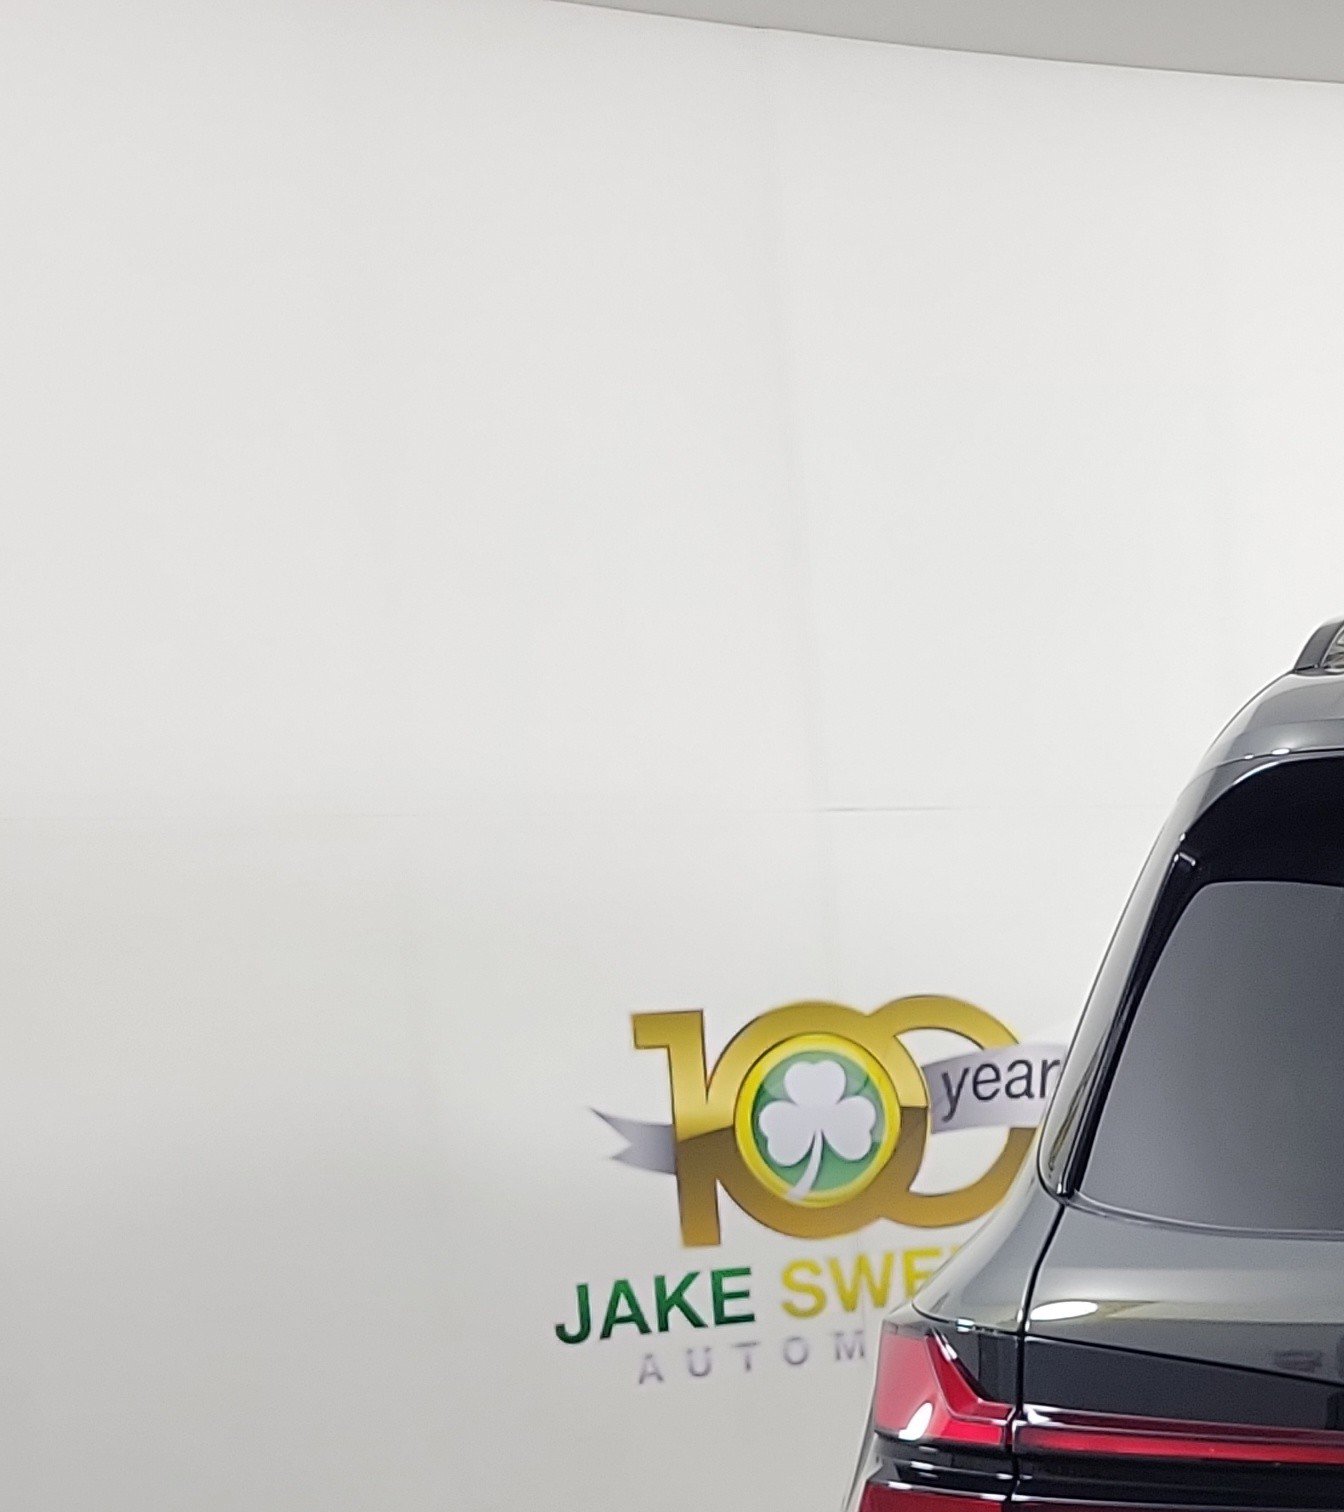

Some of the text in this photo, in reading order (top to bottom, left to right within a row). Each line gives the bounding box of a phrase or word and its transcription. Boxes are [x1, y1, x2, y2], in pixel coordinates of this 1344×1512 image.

[630, 994, 1061, 1248] 100 year
[555, 1244, 960, 1345] JAKE SWE
[637, 1330, 867, 1385] AUTOM
